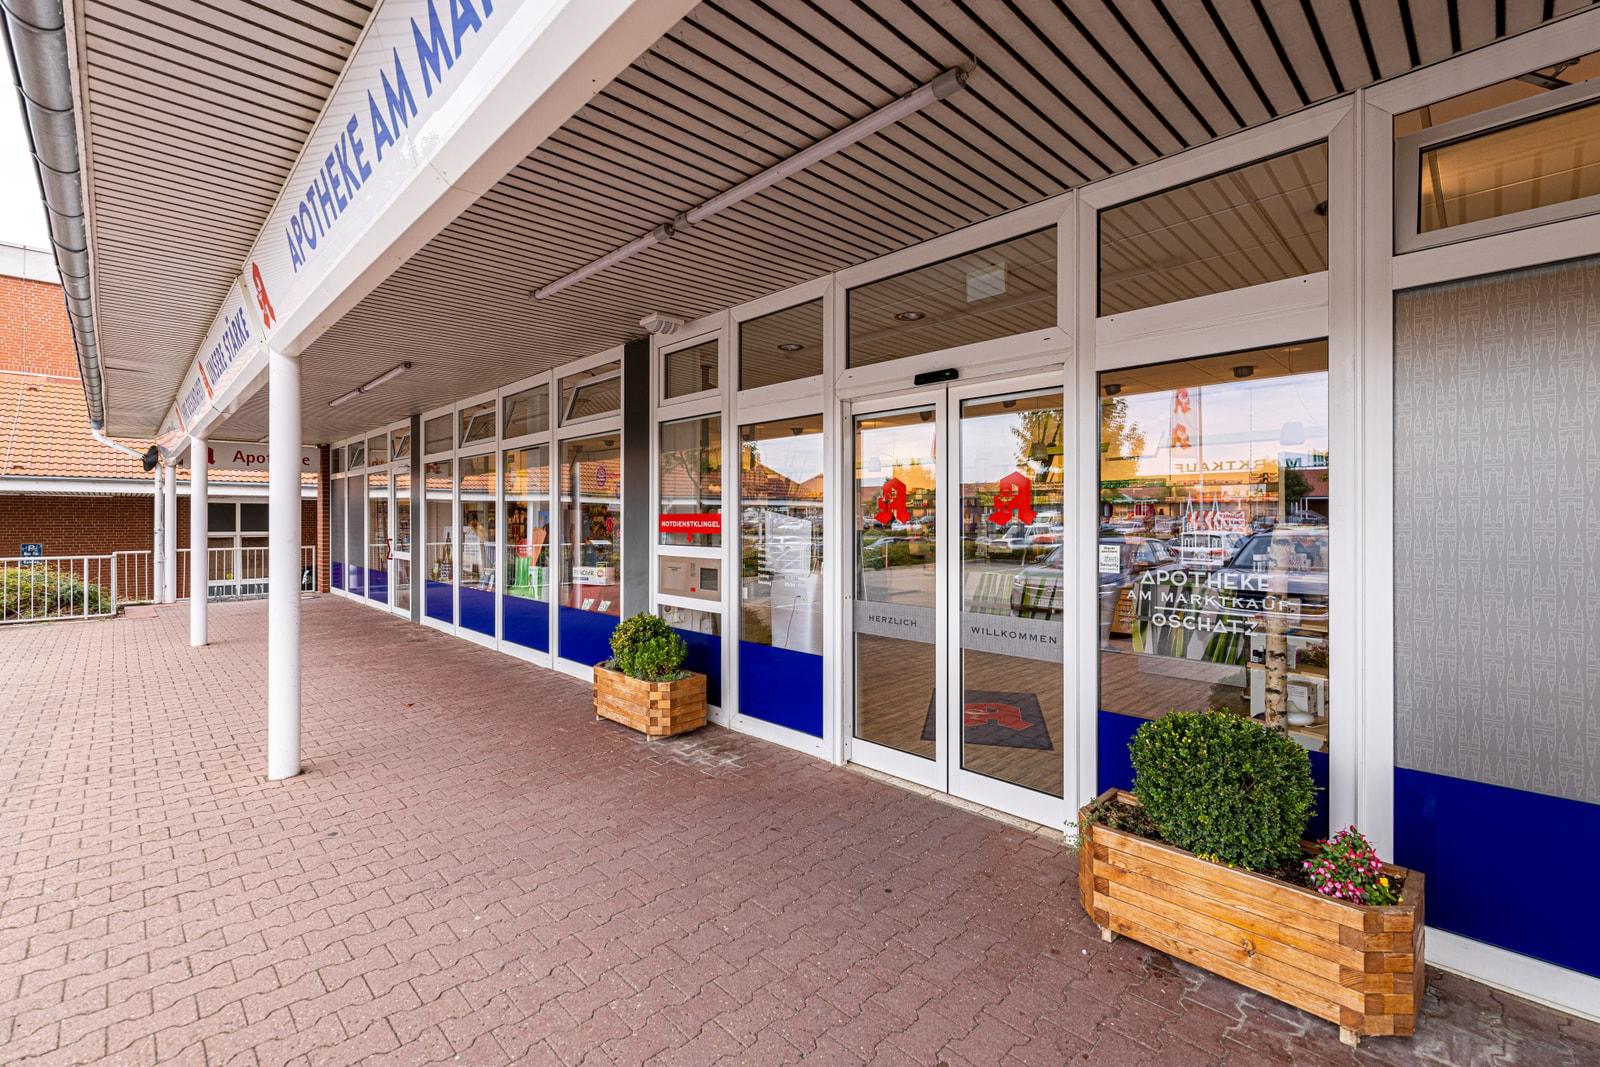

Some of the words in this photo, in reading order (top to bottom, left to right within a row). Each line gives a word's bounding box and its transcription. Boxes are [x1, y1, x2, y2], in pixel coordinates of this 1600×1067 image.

[285, 113, 373, 273] APOTHEKE
[367, 46, 418, 163] AM
[410, 0, 495, 99] MA
[205, 343, 228, 386] UNSERE
[223, 307, 250, 363] STÄRKE
[233, 450, 310, 466] Apoe
[661, 520, 721, 528] NOTDIENSTKLINGEL
[1140, 569, 1273, 592] APOTHEKE
[1126, 590, 1152, 601] AM
[1161, 590, 1290, 611] MARKTKAUF
[868, 614, 917, 627] HERZLICH
[1152, 612, 1259, 637] OSCHATZ
[970, 626, 1057, 644] WILLKOMMEN
